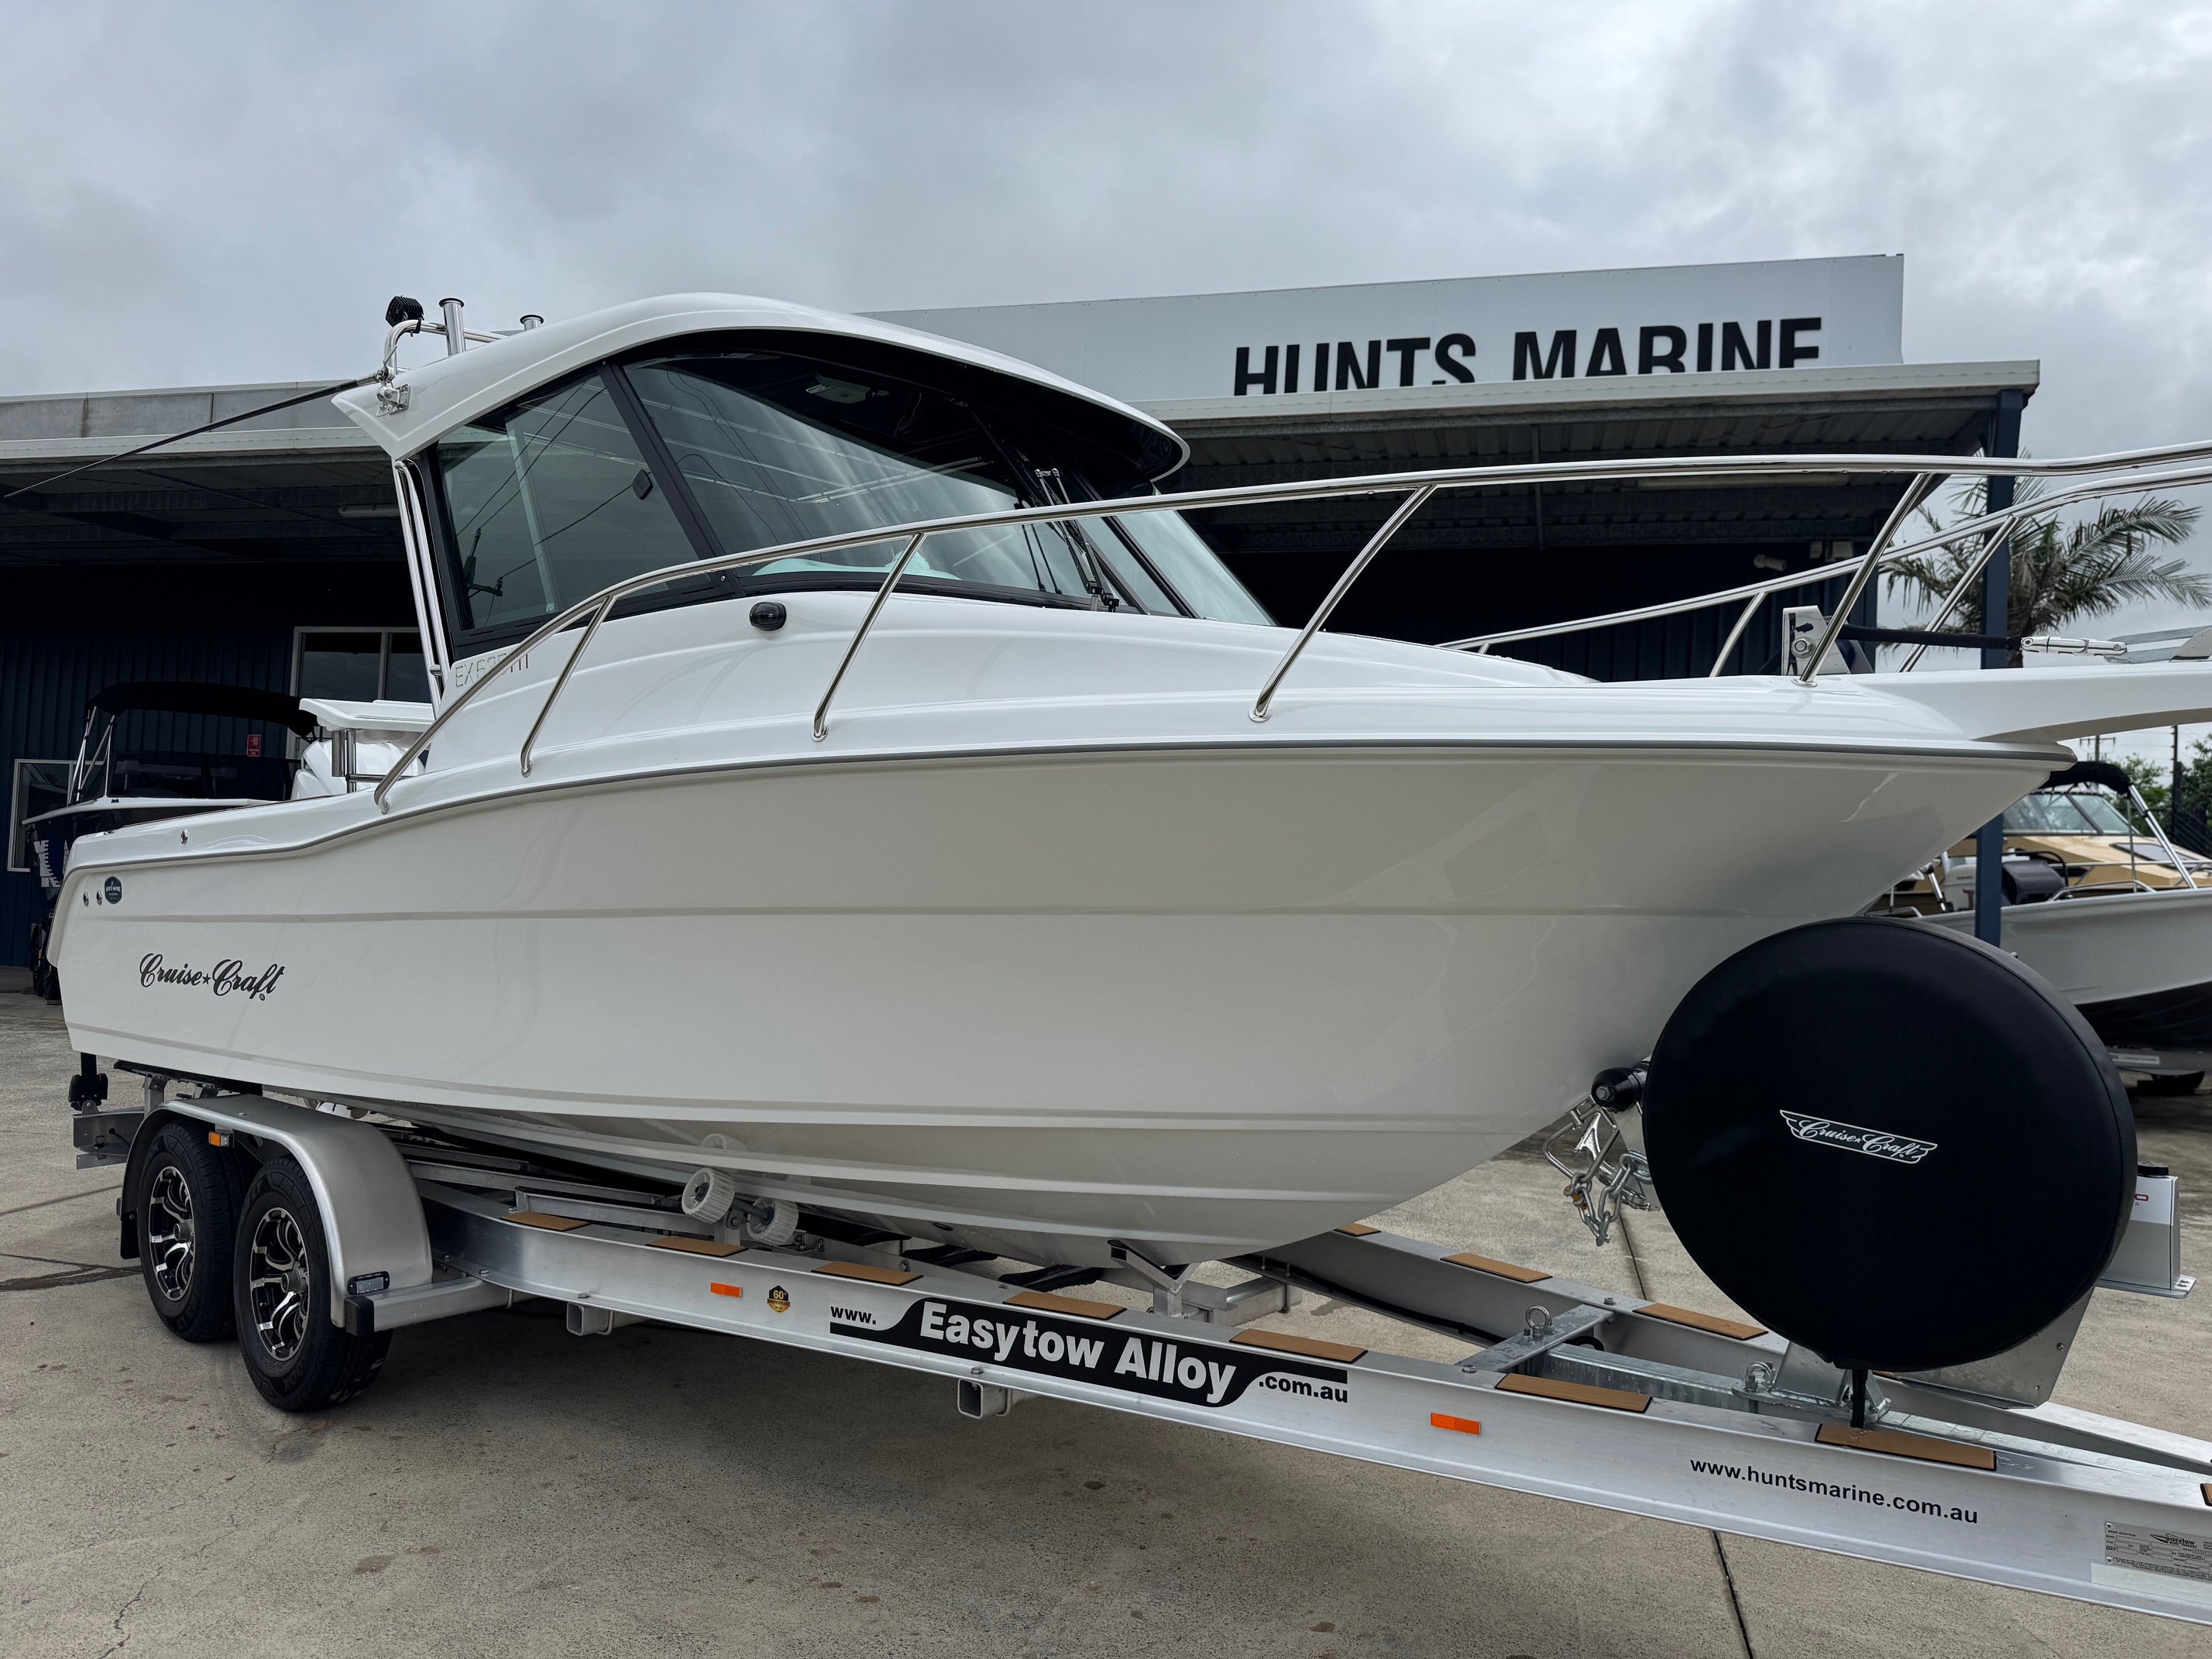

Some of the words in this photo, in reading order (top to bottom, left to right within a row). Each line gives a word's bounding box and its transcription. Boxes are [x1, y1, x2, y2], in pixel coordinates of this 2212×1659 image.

[1234, 333, 1476, 396] HUNTS
[1512, 317, 1822, 380] MARINE
[139, 953, 203, 988] Cruise
[211, 959, 285, 999] Craft
[1798, 1120, 1857, 1142] Cruise
[1862, 1134, 1921, 1157] Craft
[830, 1306, 877, 1325] www.
[919, 1301, 1105, 1369] Easytow
[1114, 1337, 1237, 1403] Alloy
[1259, 1375, 1348, 1403] .com.au
[1689, 1459, 1978, 1524] www.huntsmarine.com.au
